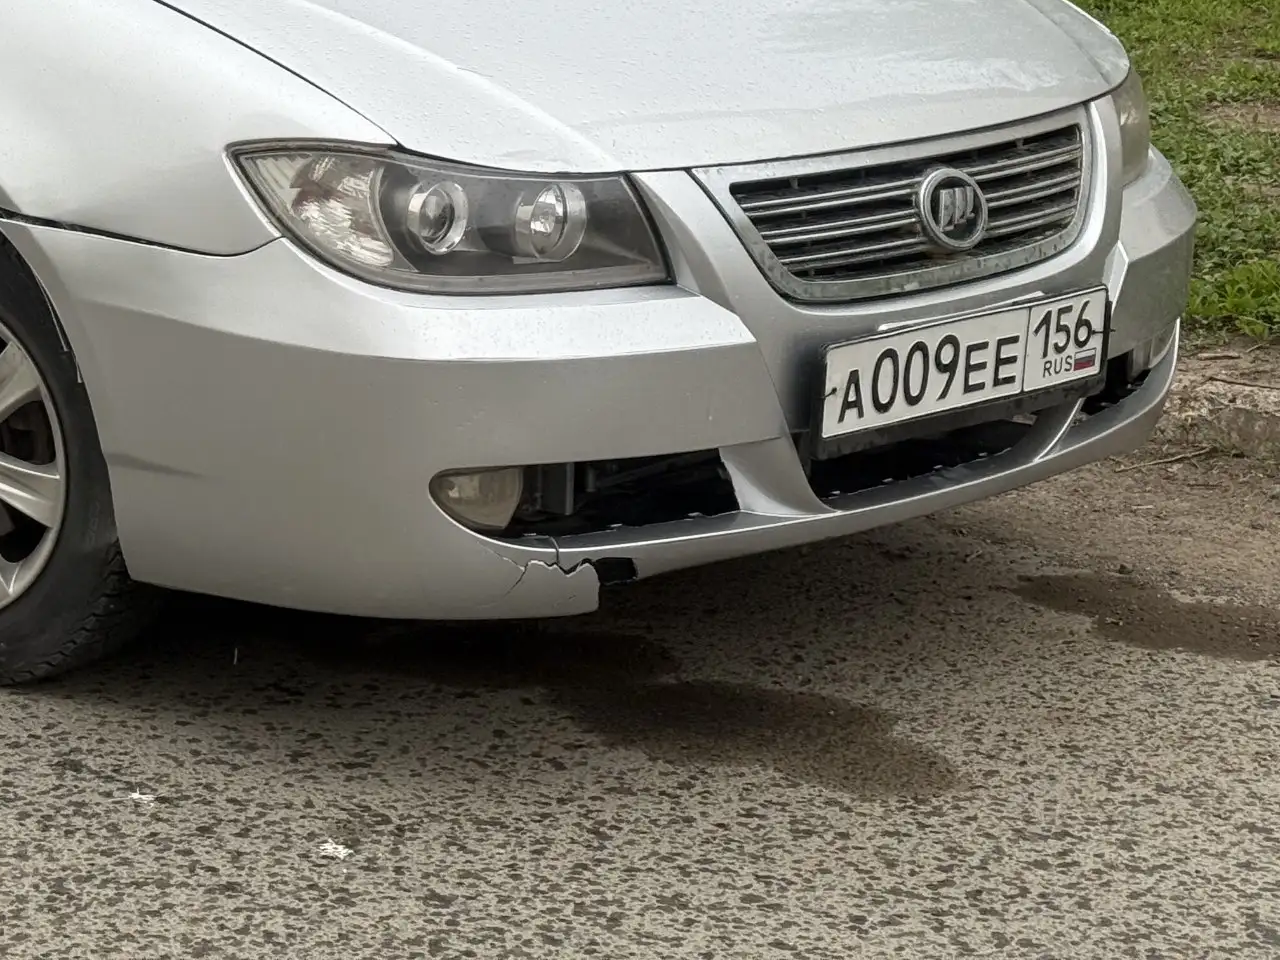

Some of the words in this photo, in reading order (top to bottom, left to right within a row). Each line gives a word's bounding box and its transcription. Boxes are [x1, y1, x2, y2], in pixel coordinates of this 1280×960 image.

[837, 334, 1020, 423] А009ЕЕ
[1033, 300, 1094, 359] 156
[1042, 354, 1074, 378] RUS
